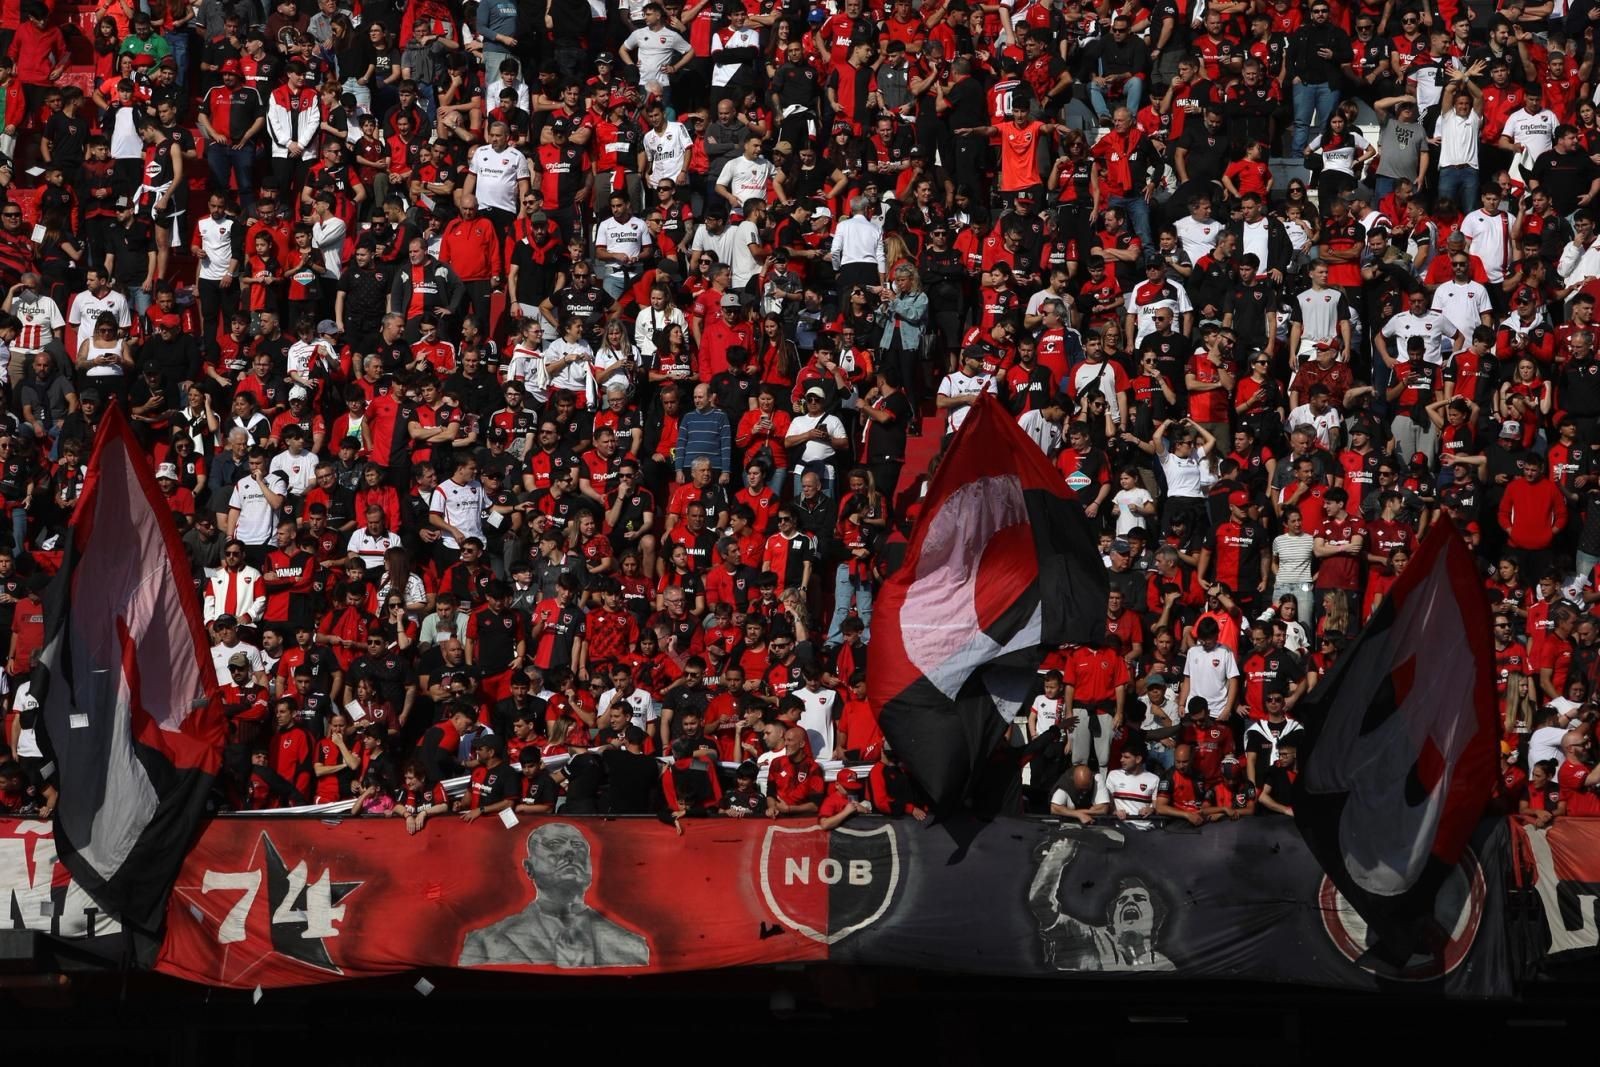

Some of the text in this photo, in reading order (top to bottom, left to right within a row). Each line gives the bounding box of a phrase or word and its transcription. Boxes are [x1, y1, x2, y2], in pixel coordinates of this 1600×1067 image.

[686, 548, 706, 556] AMAHA
[275, 567, 302, 577] YAMAHA
[784, 856, 873, 886] NOB
[202, 859, 346, 944] 74
